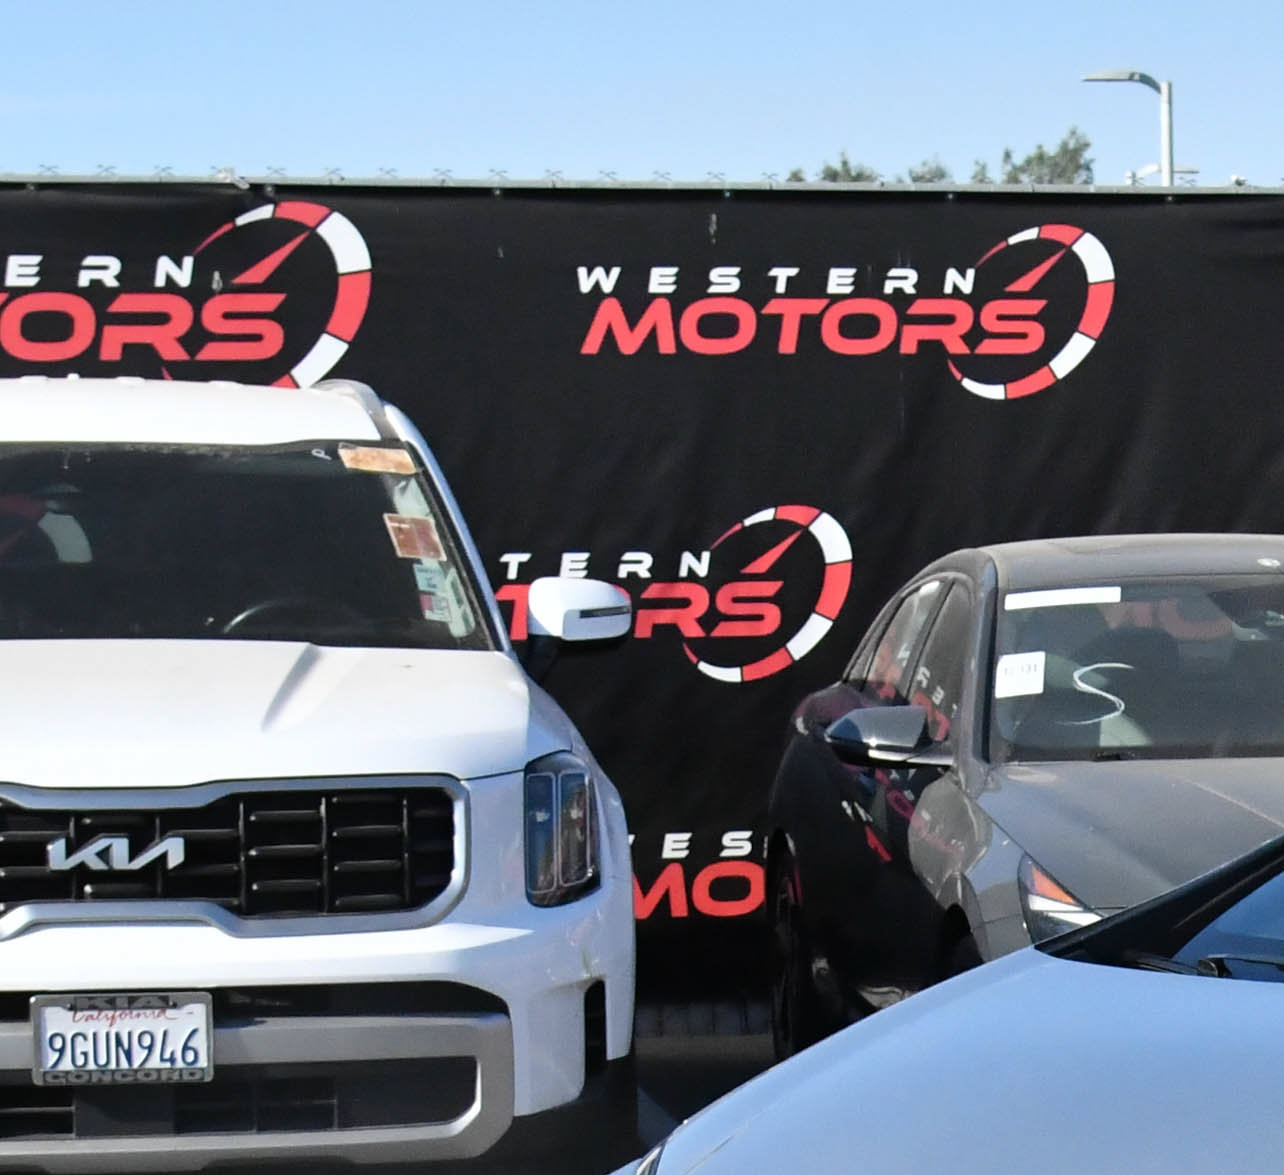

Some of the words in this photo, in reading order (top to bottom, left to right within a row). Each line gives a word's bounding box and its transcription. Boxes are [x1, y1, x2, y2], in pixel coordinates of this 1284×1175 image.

[577, 266, 976, 295] WESTERN
[0, 292, 288, 362] ORS
[580, 297, 1048, 356] MOTORS
[47, 833, 185, 871] KIA
[48, 1027, 200, 1069] 9GUN946
[45, 1069, 205, 1085] CONCORD
